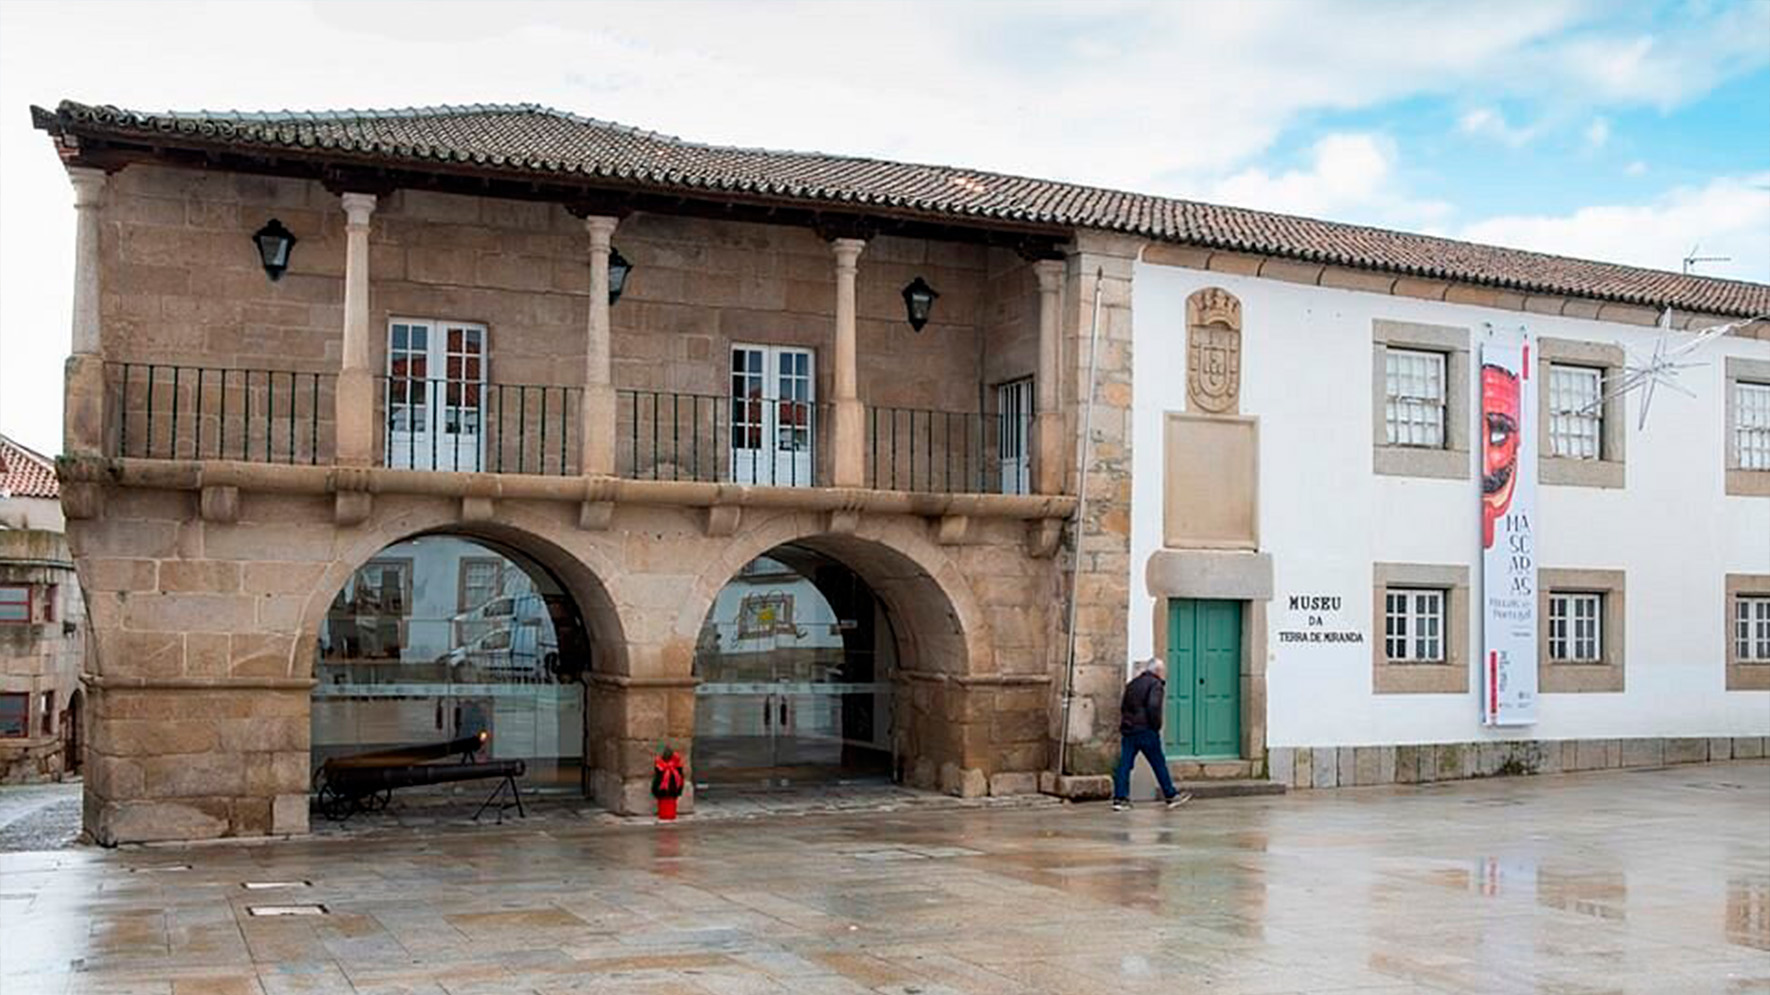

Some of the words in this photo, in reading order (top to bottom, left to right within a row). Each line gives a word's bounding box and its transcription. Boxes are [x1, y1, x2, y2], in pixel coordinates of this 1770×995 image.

[1509, 534, 1531, 554] SC
[1508, 556, 1531, 574] AR
[1510, 577, 1531, 596] AS
[1289, 596, 1341, 610] MUSEU
[1308, 615, 1323, 626] DA
[1279, 632, 1308, 642] TERRA
[1310, 632, 1321, 642] DE
[1324, 632, 1364, 643] MIRANDA
